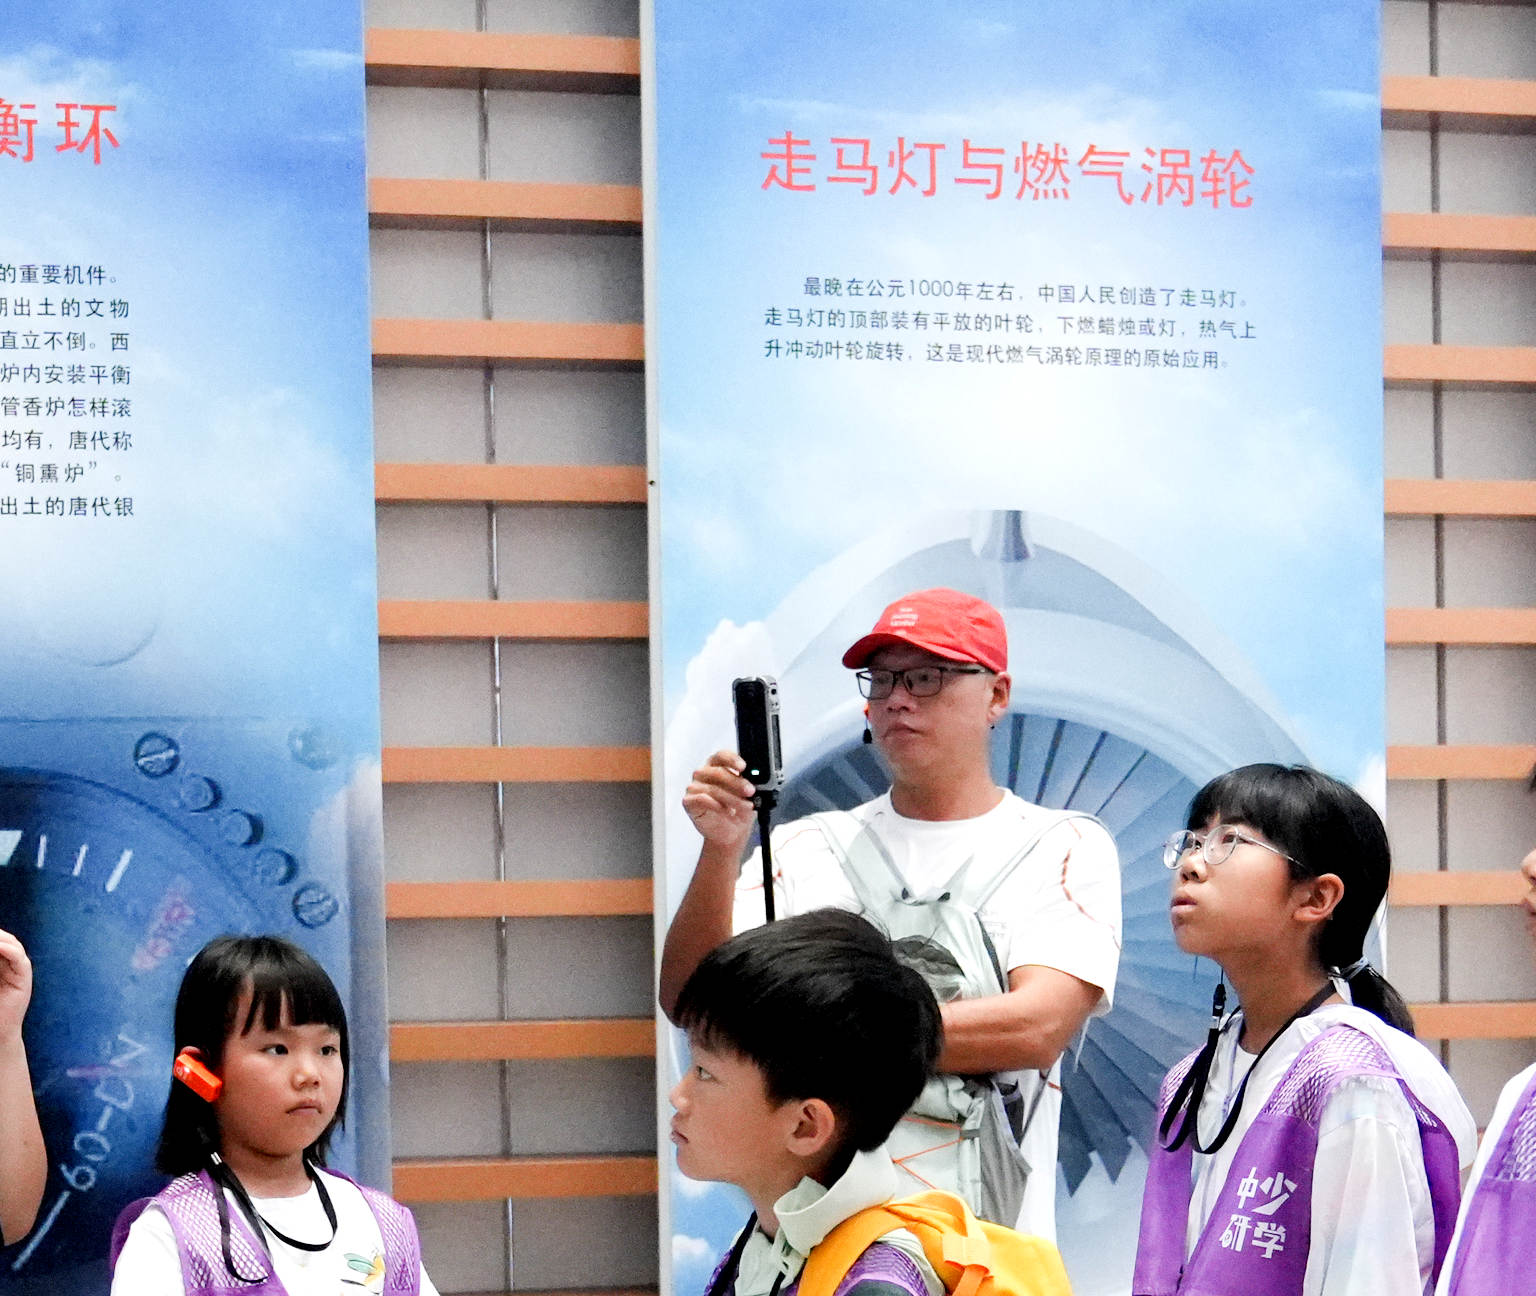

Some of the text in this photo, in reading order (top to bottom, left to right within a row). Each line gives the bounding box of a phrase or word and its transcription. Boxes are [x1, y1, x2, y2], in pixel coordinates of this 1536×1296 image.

[761, 131, 1255, 208] 走马灯与燃气涡轮
[1219, 1213, 1287, 1259] 研学
